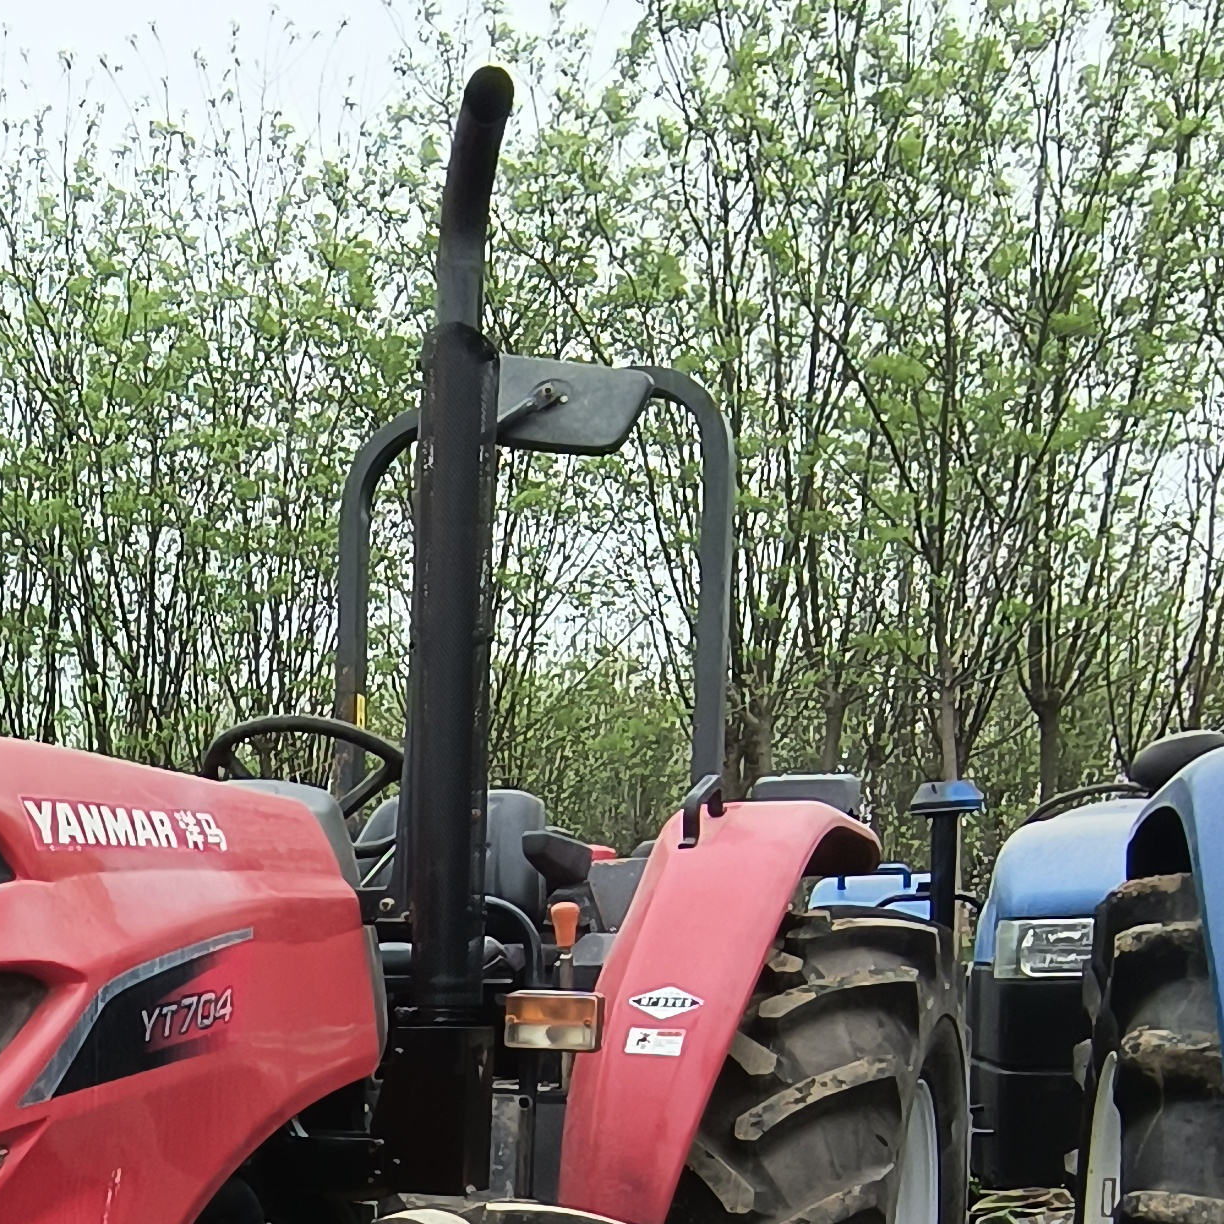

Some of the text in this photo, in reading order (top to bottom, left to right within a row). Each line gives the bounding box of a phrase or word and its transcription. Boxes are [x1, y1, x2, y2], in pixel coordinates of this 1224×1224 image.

[24, 800, 228, 852] YANMAR 洋马
[141, 988, 233, 1042] YT704
